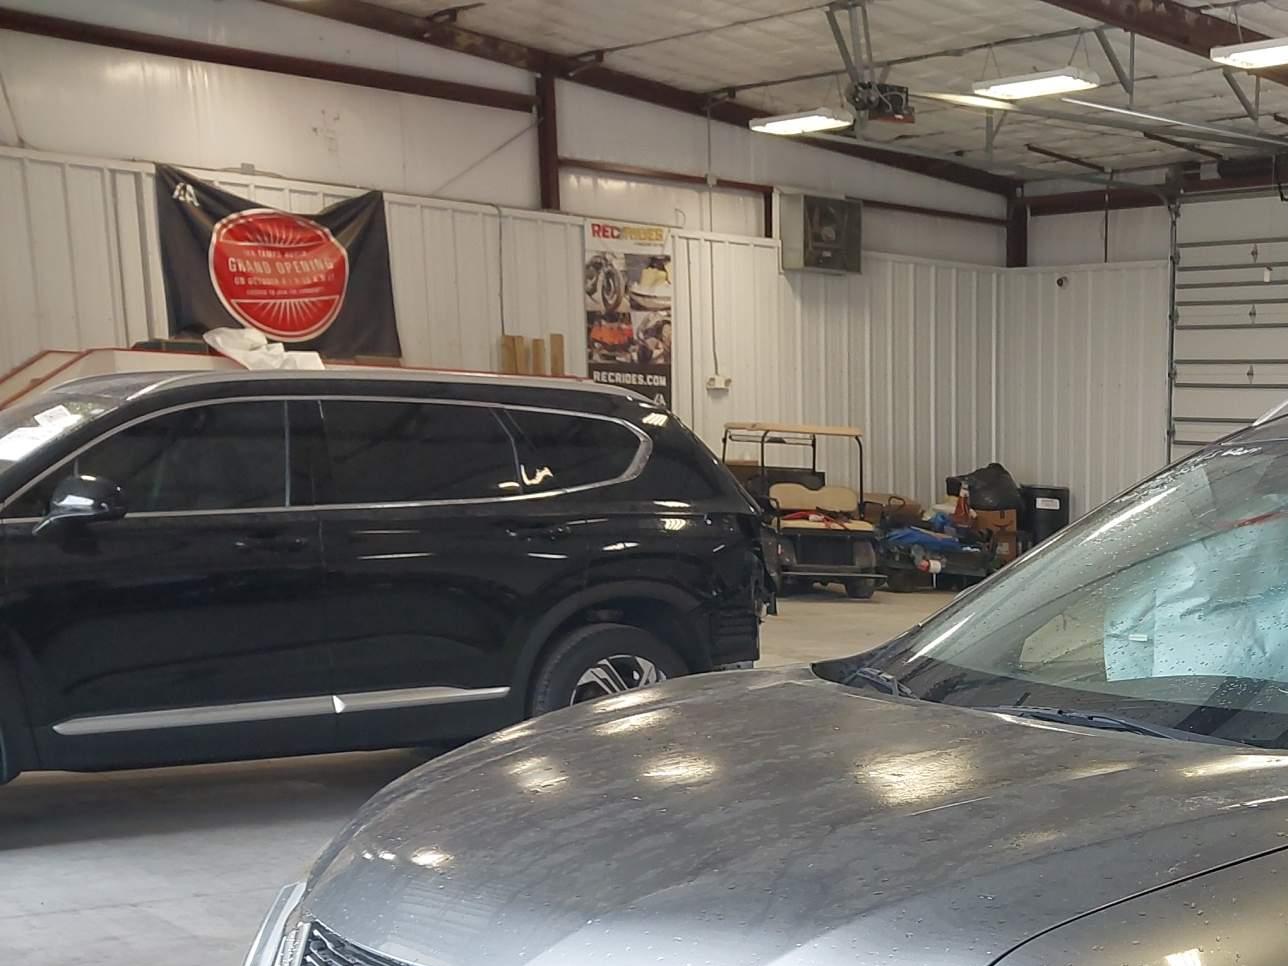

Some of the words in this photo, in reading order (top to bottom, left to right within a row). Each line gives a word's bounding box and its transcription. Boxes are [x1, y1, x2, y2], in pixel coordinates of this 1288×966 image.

[228, 256, 272, 274] GRAND
[275, 257, 335, 274] OPENING
[593, 370, 667, 387] RECRIDES.COM
